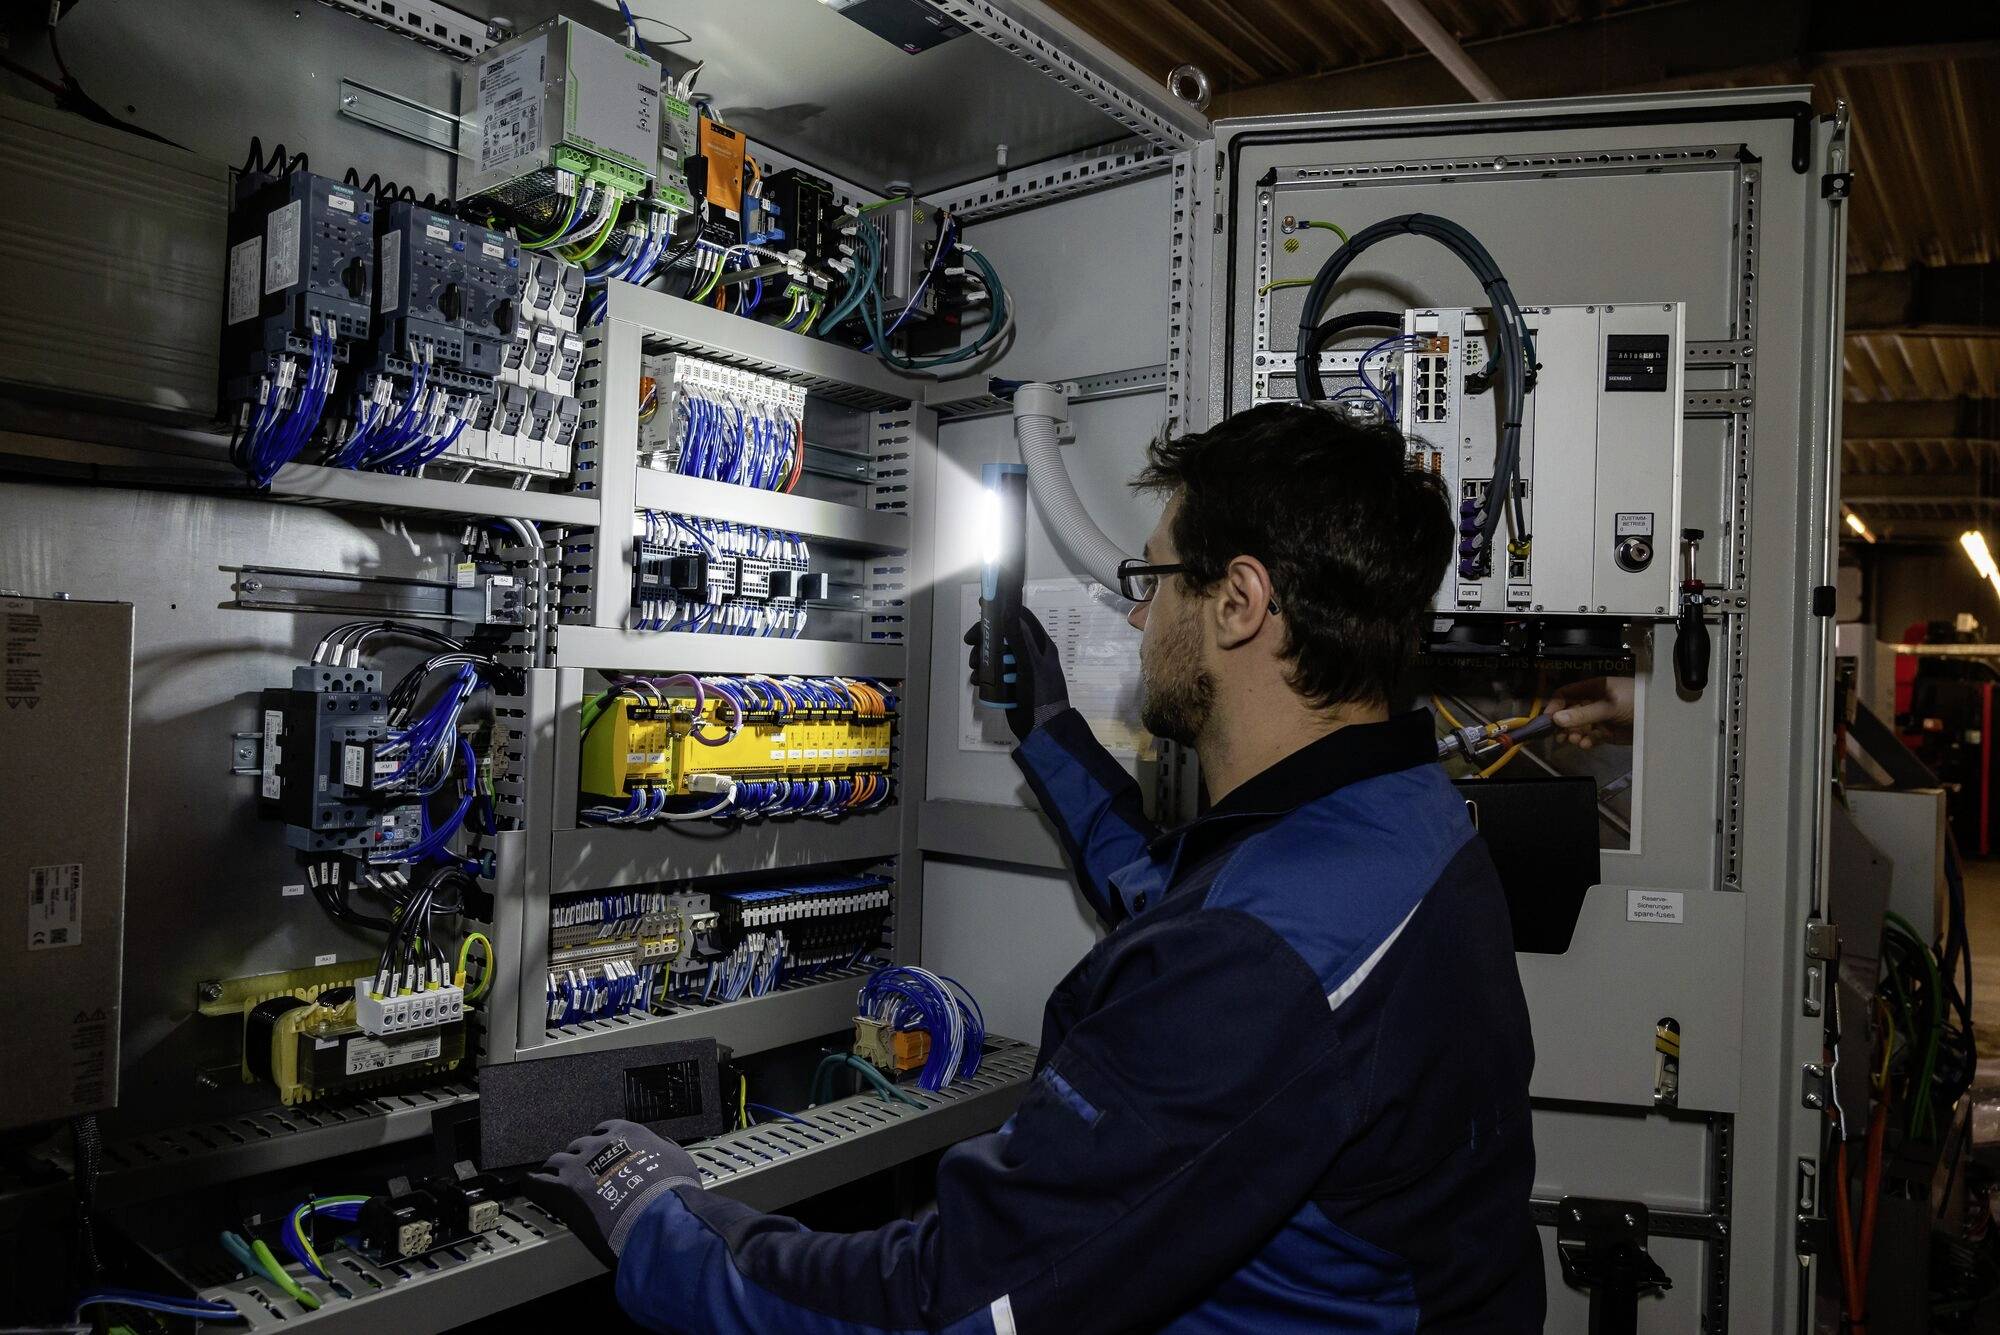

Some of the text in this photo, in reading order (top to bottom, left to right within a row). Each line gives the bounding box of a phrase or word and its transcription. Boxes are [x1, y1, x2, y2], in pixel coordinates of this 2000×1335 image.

[1637, 902, 1673, 910] Sicherungen
[1633, 911, 1676, 919] spare-fuses
[590, 1142, 625, 1174] HAZET
